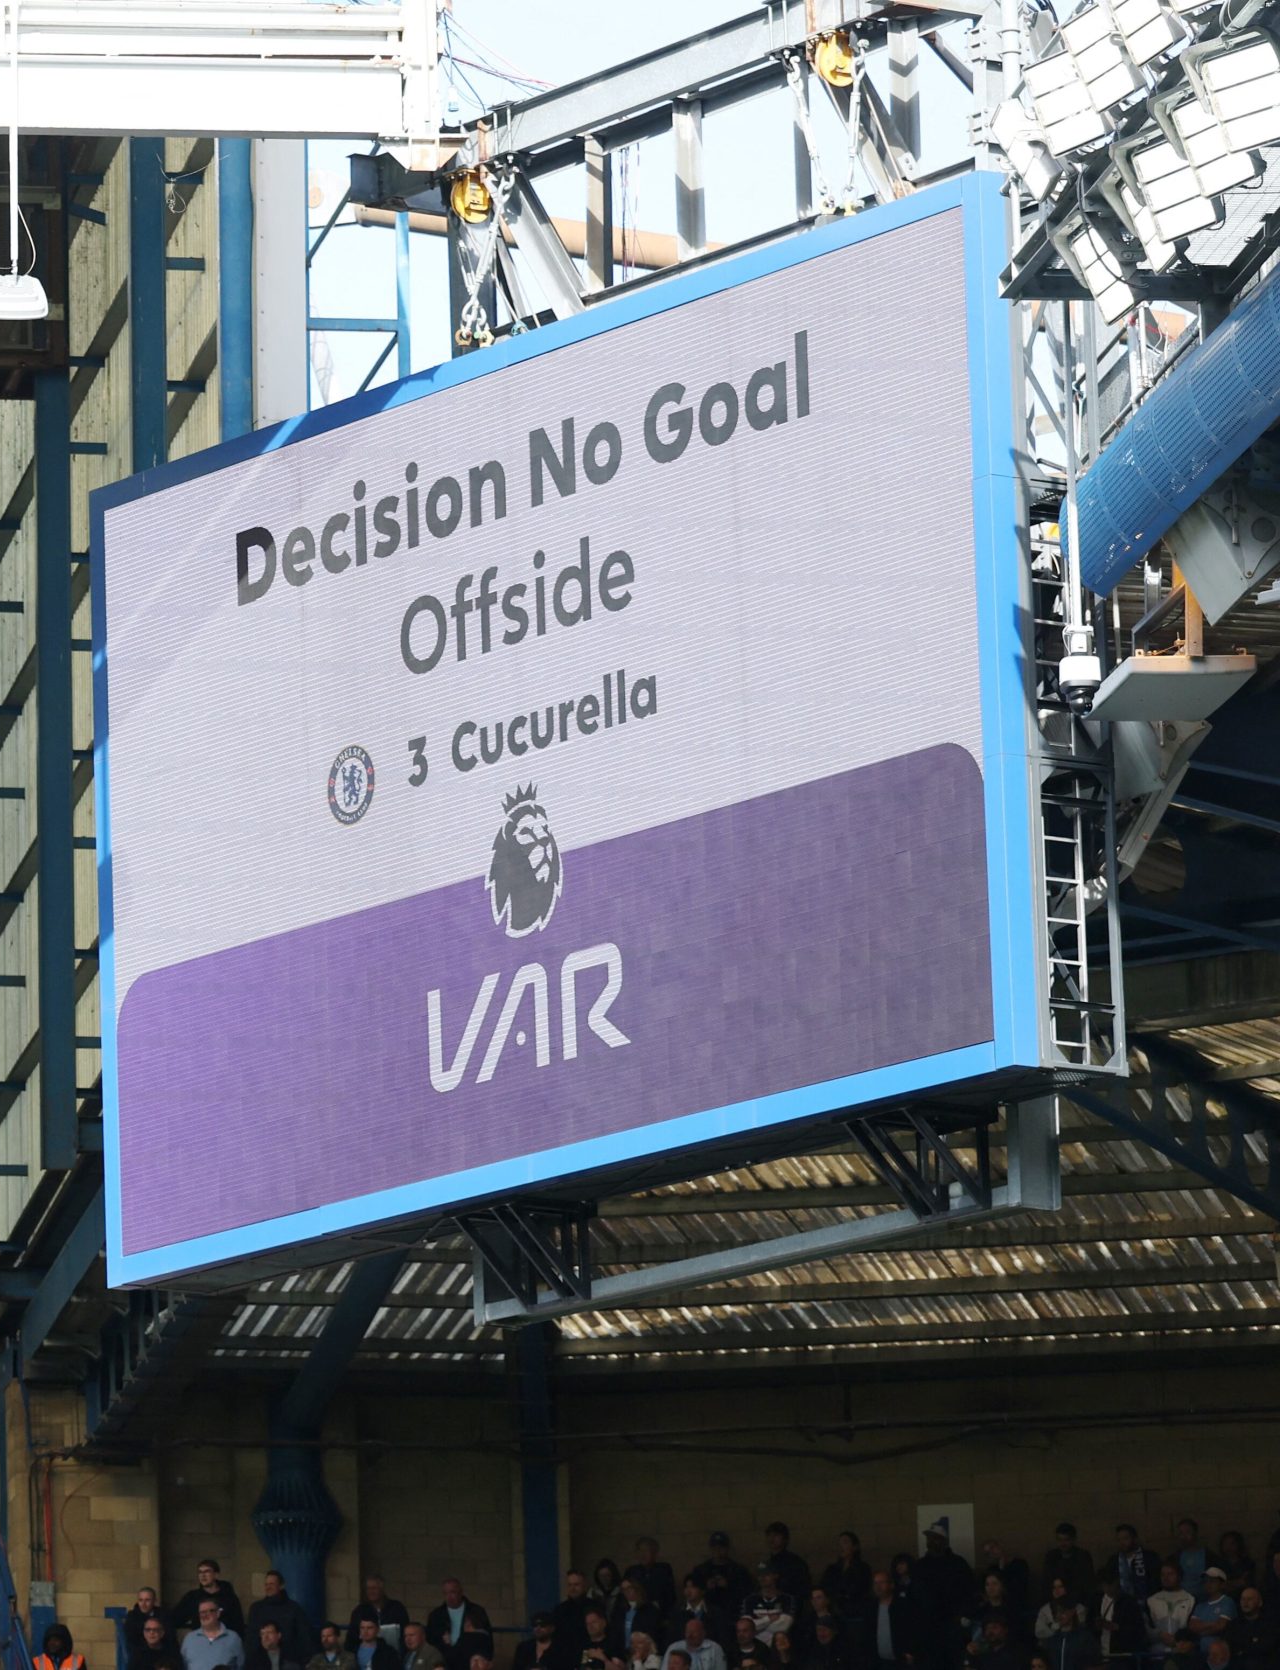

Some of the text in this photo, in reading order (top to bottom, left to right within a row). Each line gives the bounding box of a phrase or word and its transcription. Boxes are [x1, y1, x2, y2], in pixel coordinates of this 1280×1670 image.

[236, 330, 810, 606] Decision No Goal
[401, 536, 635, 675] Offside
[407, 669, 658, 787] 3 Cucurella
[427, 942, 632, 1092] VAR
